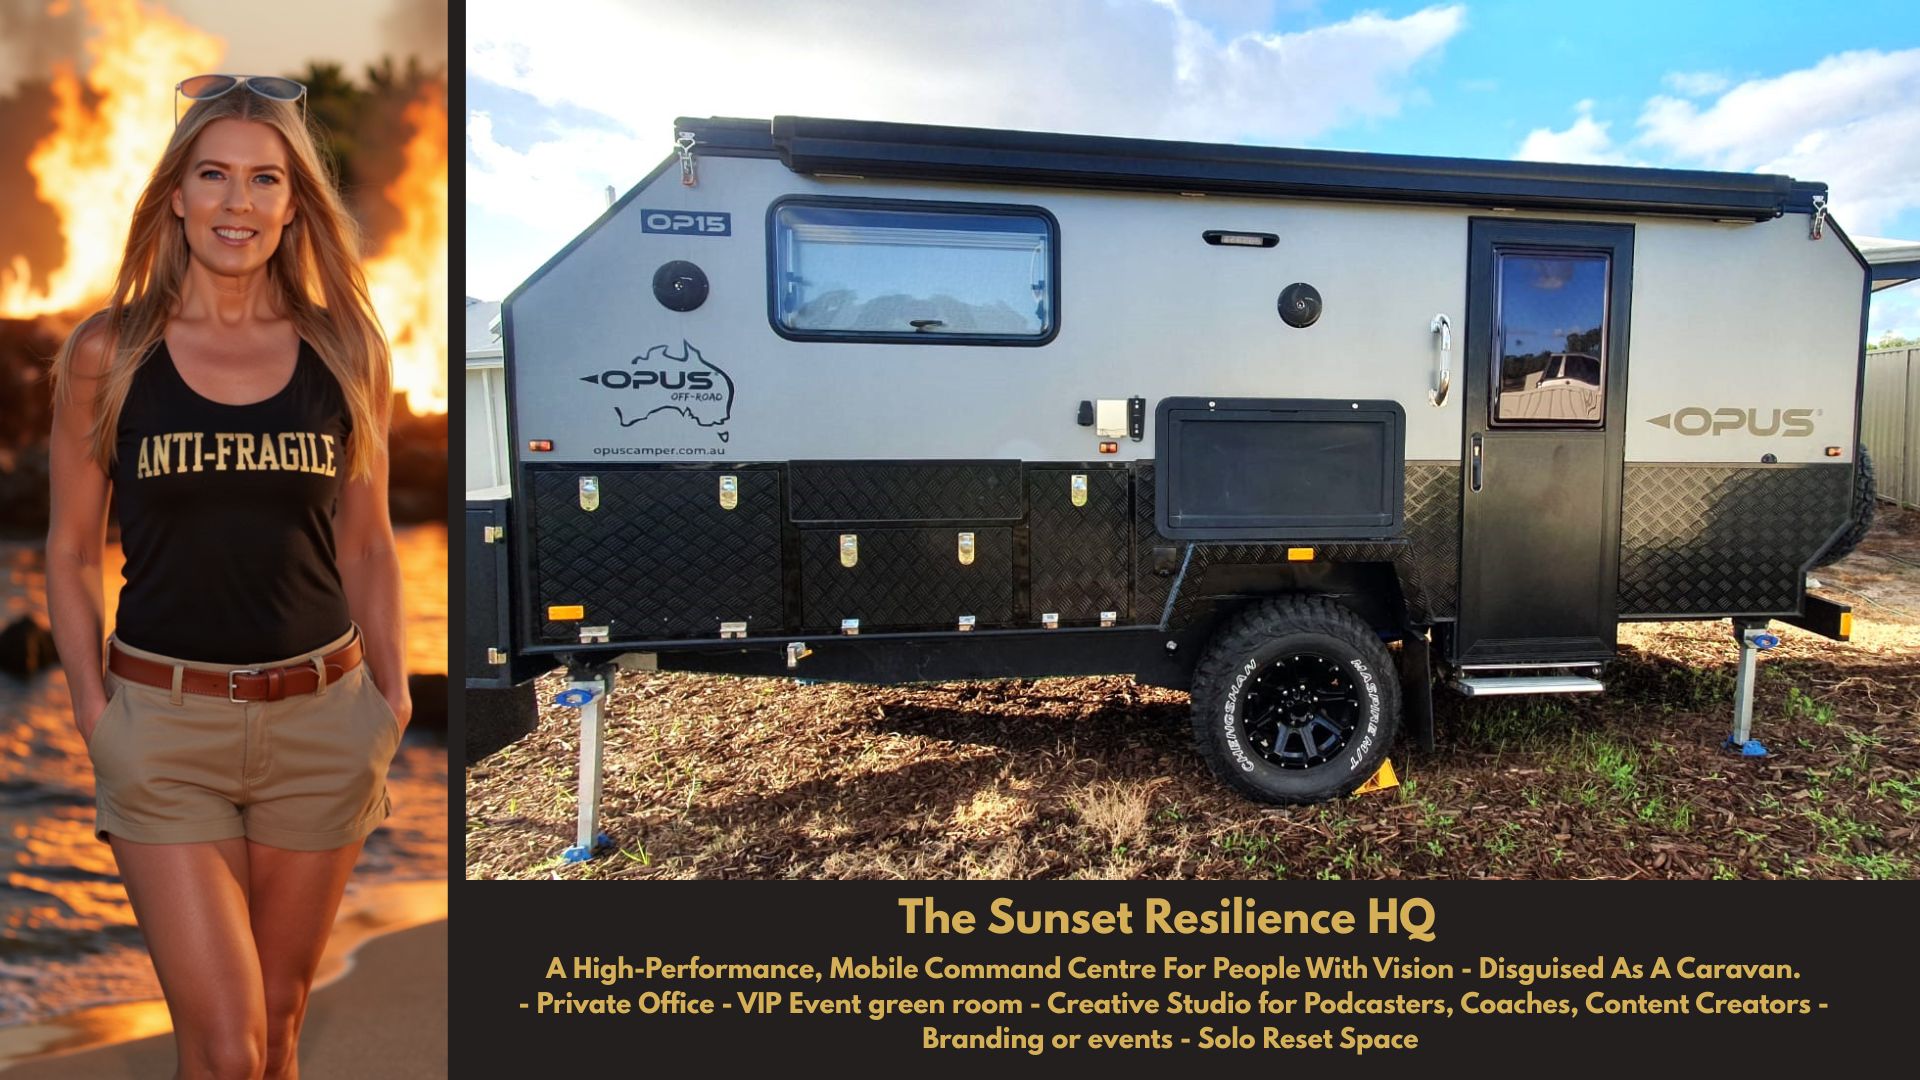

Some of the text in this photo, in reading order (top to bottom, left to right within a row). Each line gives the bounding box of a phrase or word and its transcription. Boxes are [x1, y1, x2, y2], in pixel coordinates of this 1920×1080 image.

[646, 213, 726, 233] OP15
[601, 370, 714, 390] OPUS
[670, 392, 723, 402] OFF-ROAD
[1673, 406, 1815, 438] OPUS
[137, 432, 337, 479] ANTI-FRAGILE
[593, 446, 726, 456] opuscamper.com.au
[1351, 659, 1380, 736] MASPIRE
[1224, 658, 1258, 773] CHENGSHAN
